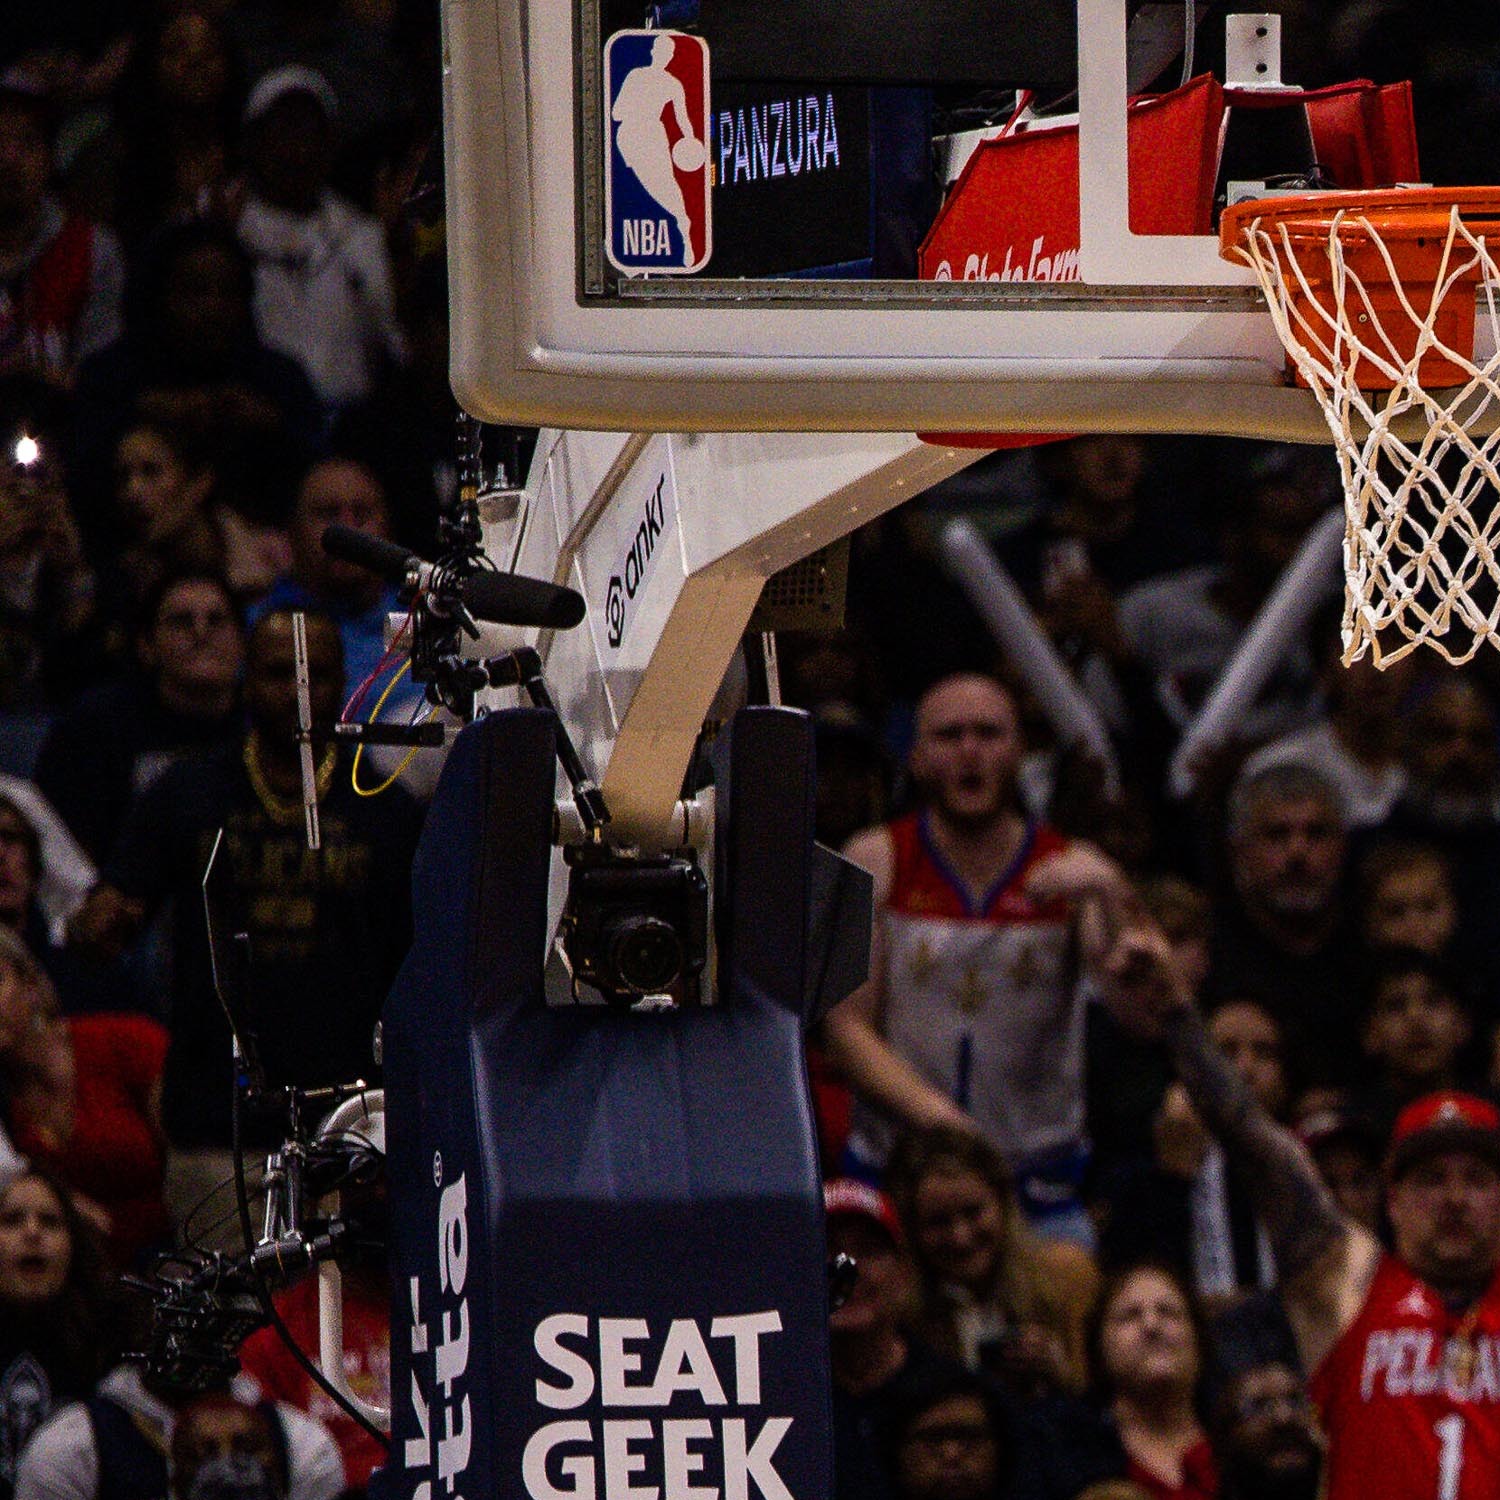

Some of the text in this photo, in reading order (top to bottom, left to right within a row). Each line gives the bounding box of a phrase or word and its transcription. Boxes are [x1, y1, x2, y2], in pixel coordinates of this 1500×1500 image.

[719, 94, 840, 186] PANZURA
[622, 218, 672, 257] NBA
[625, 473, 665, 600] ankr
[533, 1310, 784, 1411] SEAT
